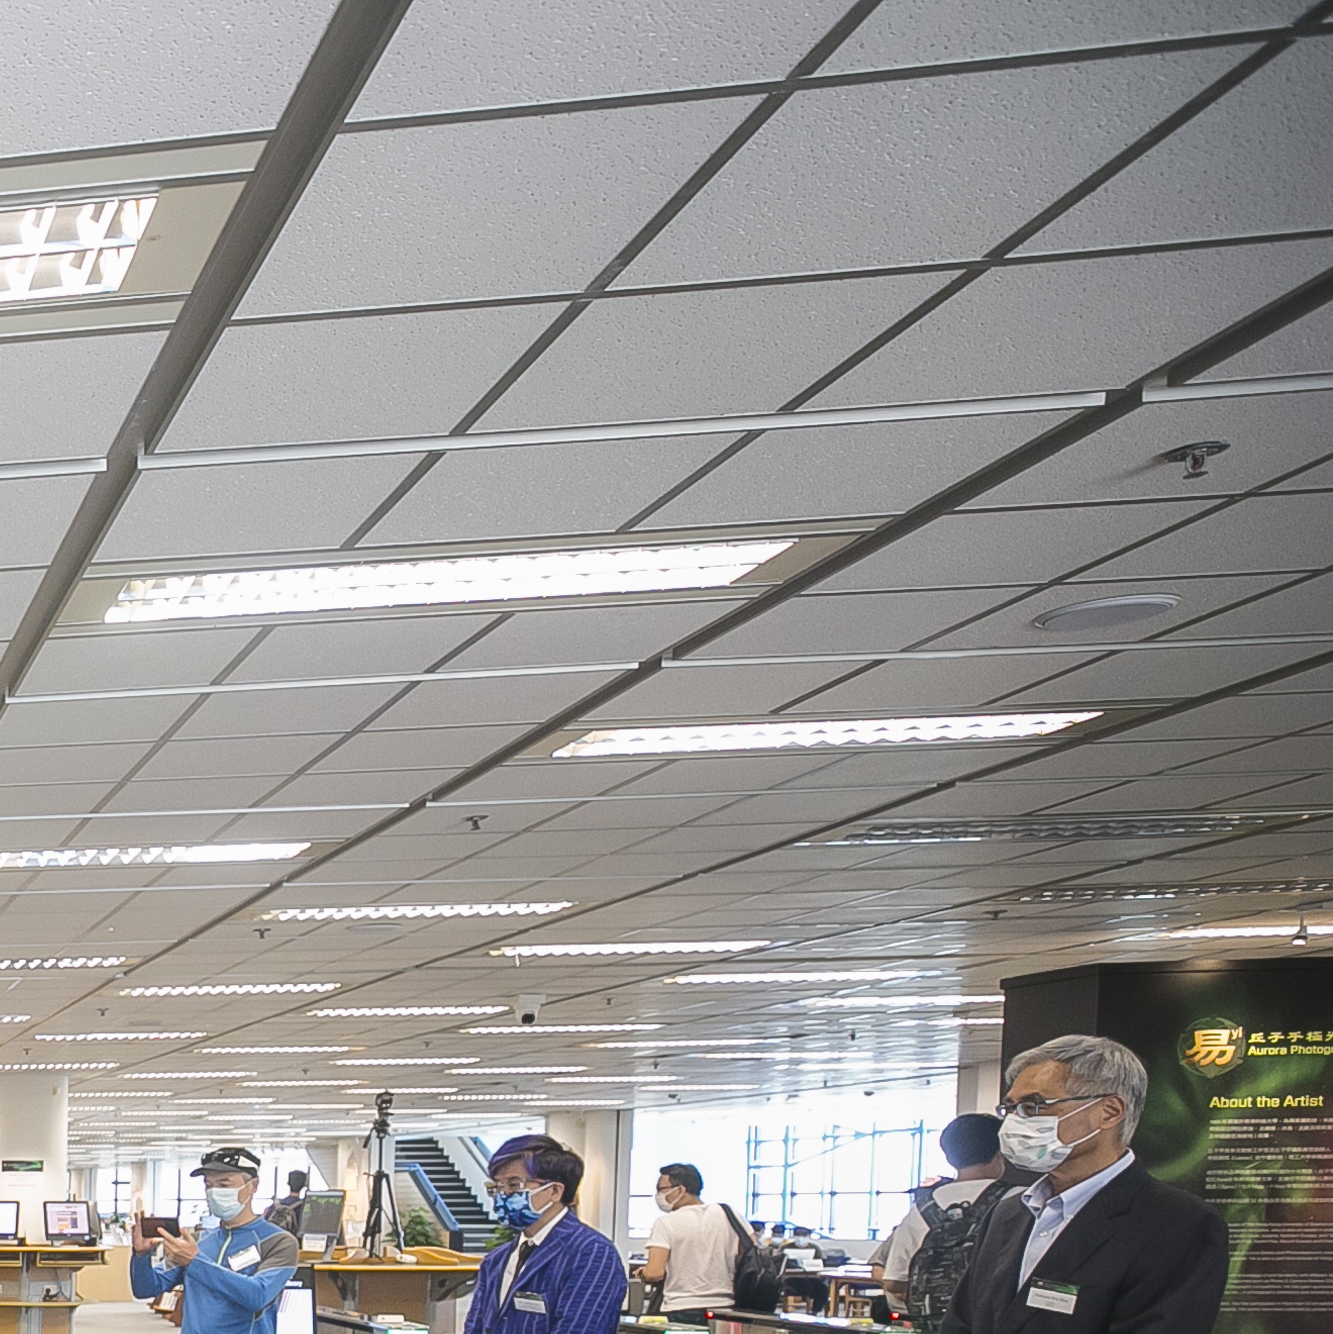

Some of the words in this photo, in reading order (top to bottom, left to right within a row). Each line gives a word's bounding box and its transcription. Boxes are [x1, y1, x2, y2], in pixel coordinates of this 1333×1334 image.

[1231, 1026, 1243, 1039] yi
[1185, 1029, 1236, 1066] 易
[1247, 1045, 1287, 1056] Aurora
[1209, 1096, 1253, 1108] About
[1256, 1096, 1280, 1107] the
[1283, 1095, 1324, 1107] Artist
